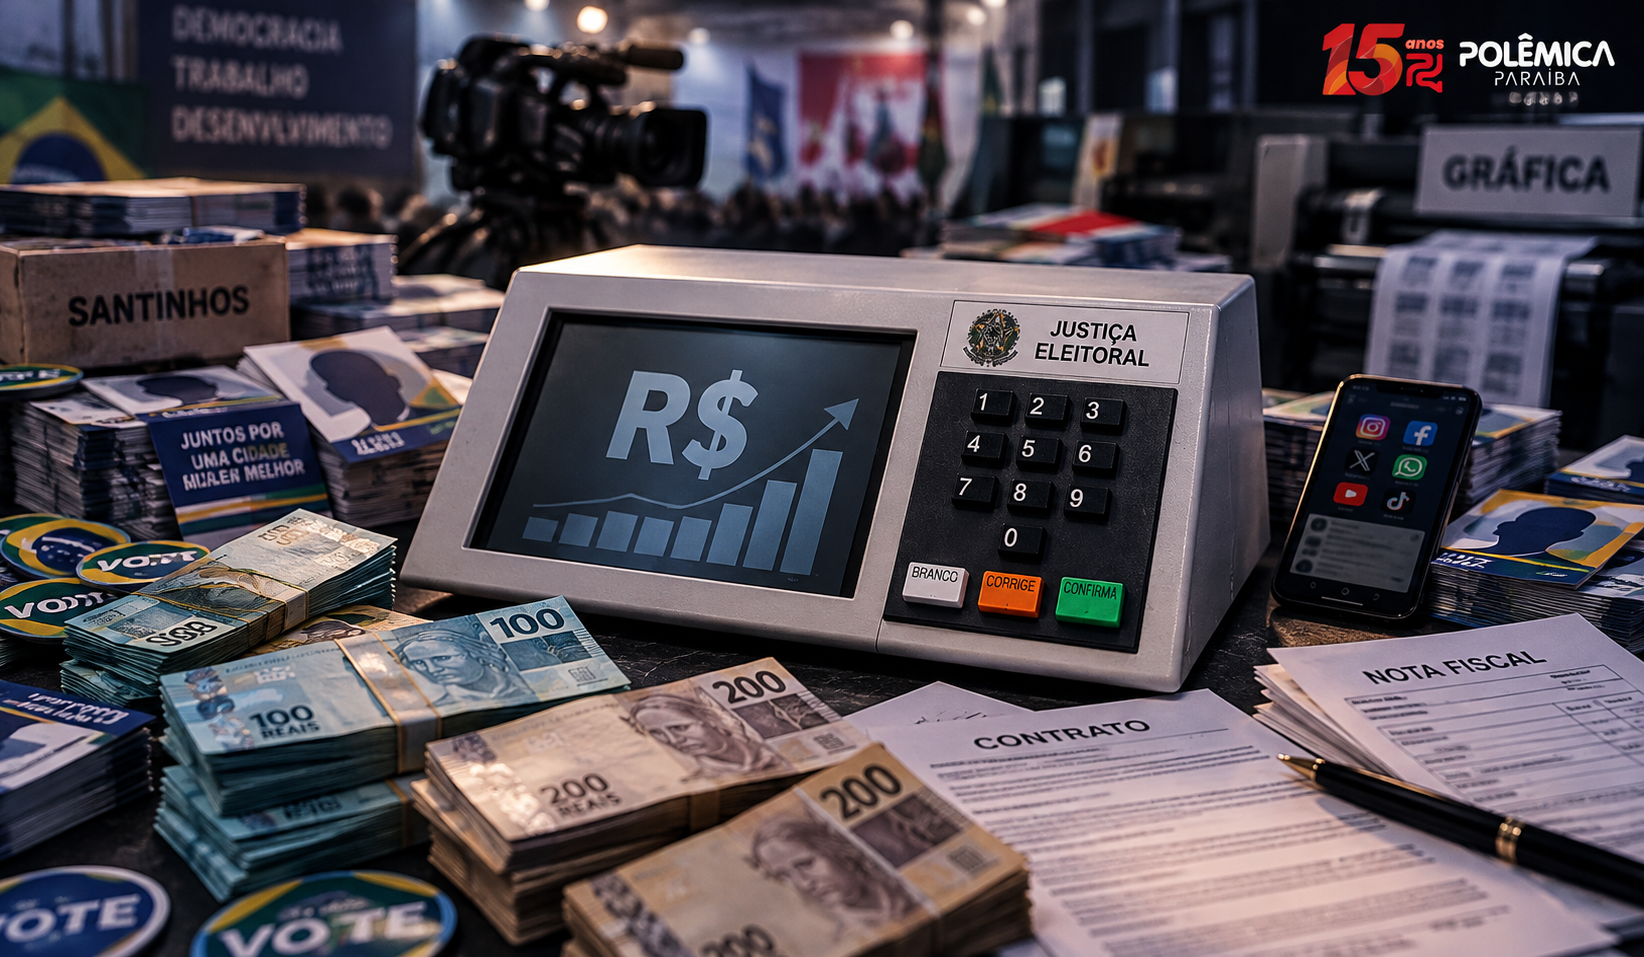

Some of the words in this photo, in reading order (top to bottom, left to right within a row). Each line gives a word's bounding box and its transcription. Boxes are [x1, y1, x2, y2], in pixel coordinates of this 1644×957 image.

[172, 5, 344, 53] DEMOCRACIA
[1442, 145, 1612, 193] GRÁFICA
[68, 285, 250, 326] SANTINHOS
[1050, 320, 1137, 345] JUSTIÇA
[1034, 342, 1150, 367] ELEITORAL
[979, 392, 989, 411] 1
[1030, 397, 1045, 416] 2
[1085, 401, 1100, 420] 3
[181, 425, 246, 450] JUNTOS
[248, 421, 285, 441] POR
[605, 369, 759, 480] R$
[190, 450, 231, 470] UMA
[232, 442, 291, 465] CIDADE
[967, 435, 981, 453] 4
[1021, 439, 1036, 458] 5
[1078, 444, 1092, 463] 6
[243, 459, 305, 482] MELHOR
[958, 477, 972, 496] 7
[1013, 483, 1027, 502] 8
[1069, 489, 1083, 508] 9
[1003, 528, 1018, 547] 0
[911, 566, 959, 583] BRANCO
[986, 575, 1037, 592] CORRIGE
[1063, 581, 1118, 600] CONFIRMA
[489, 608, 565, 638] 100
[1362, 664, 1447, 685] NOTA
[1442, 650, 1548, 675] FISCAL
[712, 671, 786, 704] 200
[250, 705, 315, 728] 100
[262, 721, 321, 740] REAIS
[973, 719, 1151, 750] CONTRATO
[539, 773, 609, 804] 200
[819, 764, 902, 820] 200
[0, 893, 141, 943] OTE
[217, 901, 428, 957] VOTE
